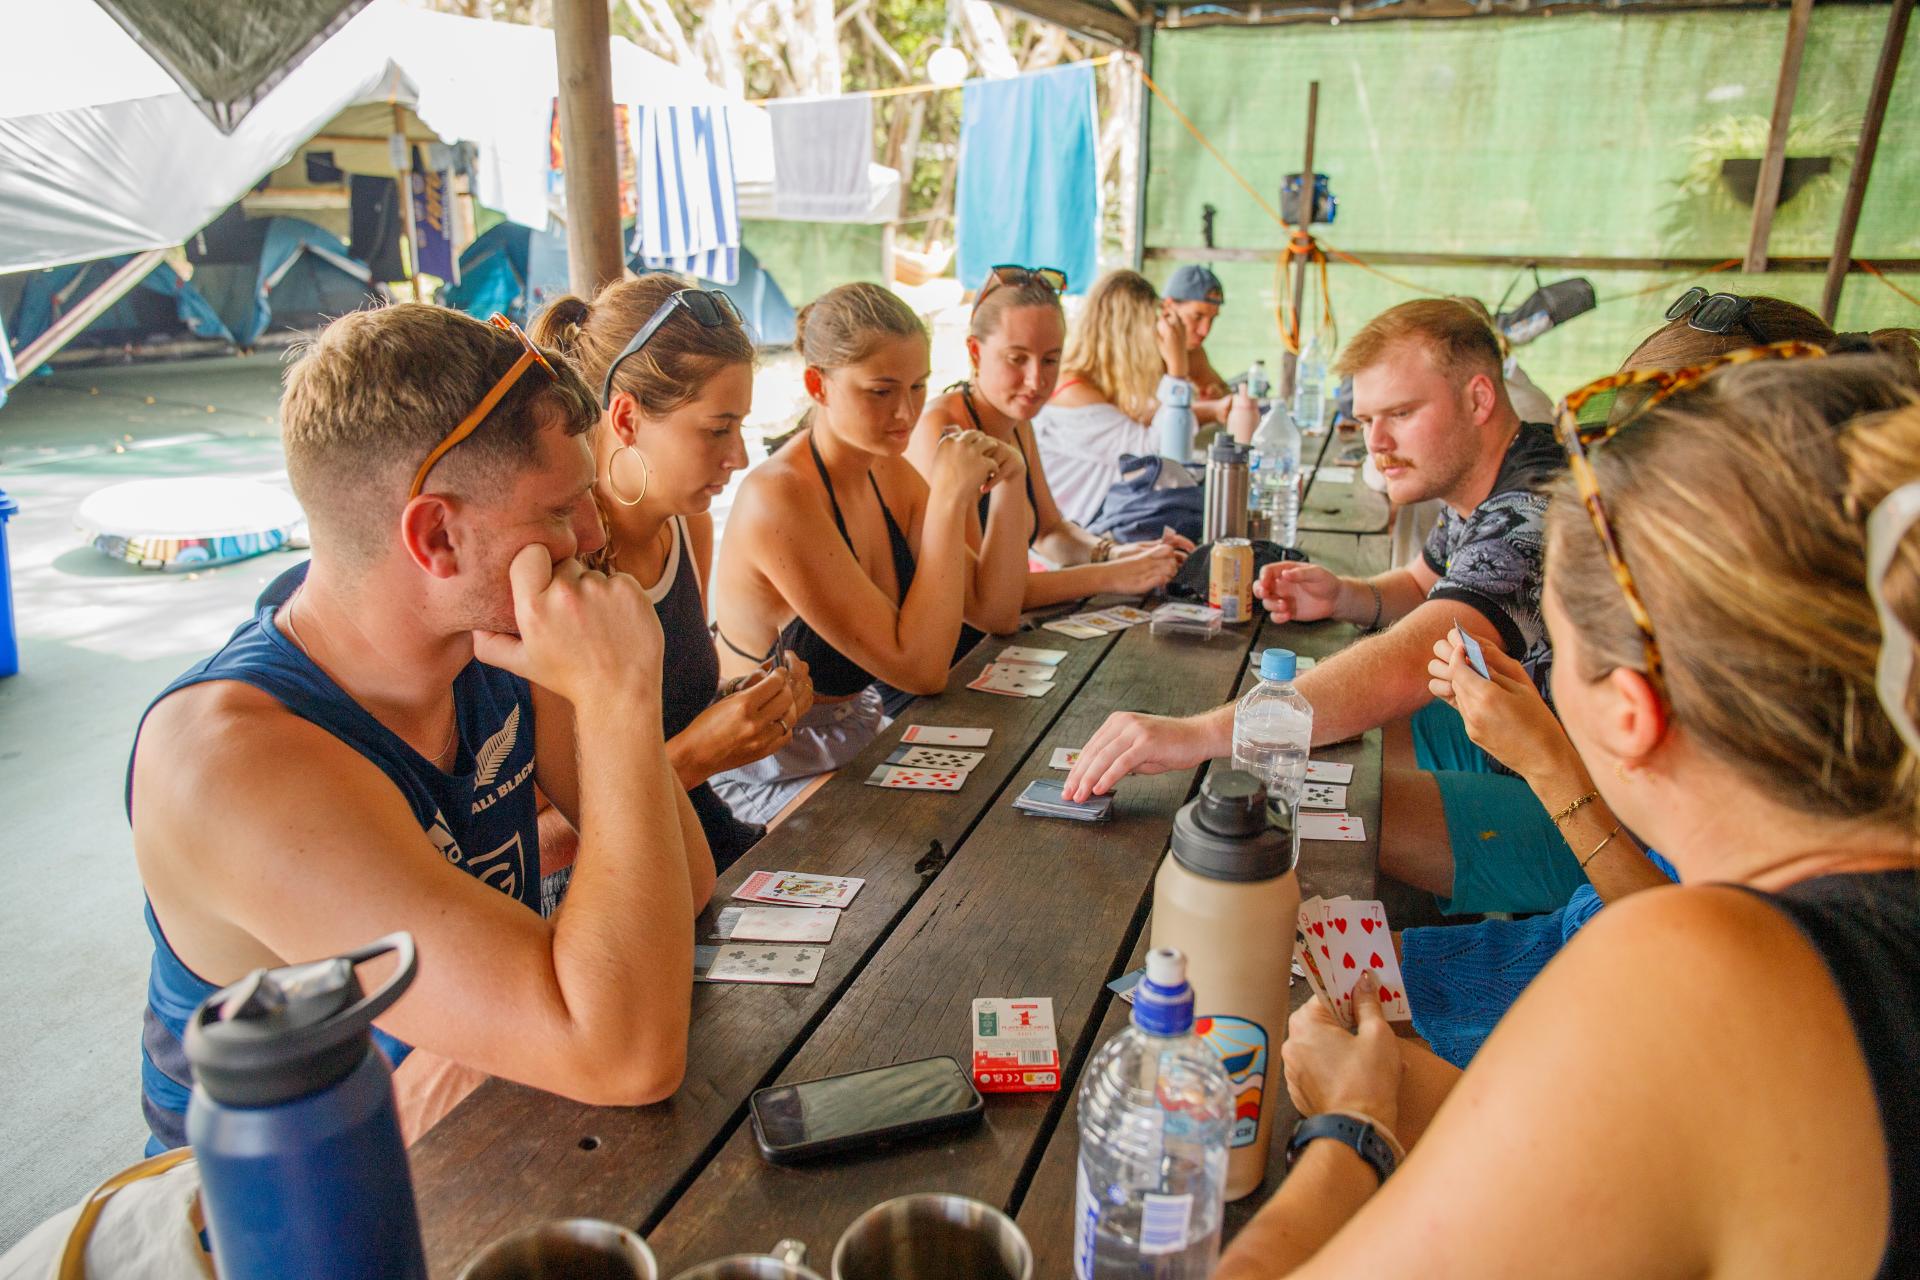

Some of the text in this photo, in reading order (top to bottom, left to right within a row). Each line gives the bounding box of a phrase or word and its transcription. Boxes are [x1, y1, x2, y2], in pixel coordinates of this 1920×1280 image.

[471, 755, 535, 815] ALL BLACK
[1301, 912, 1310, 926] 9
[1324, 905, 1331, 919] 7
[1371, 905, 1379, 919] 7
[1396, 1000, 1405, 1014] 7
